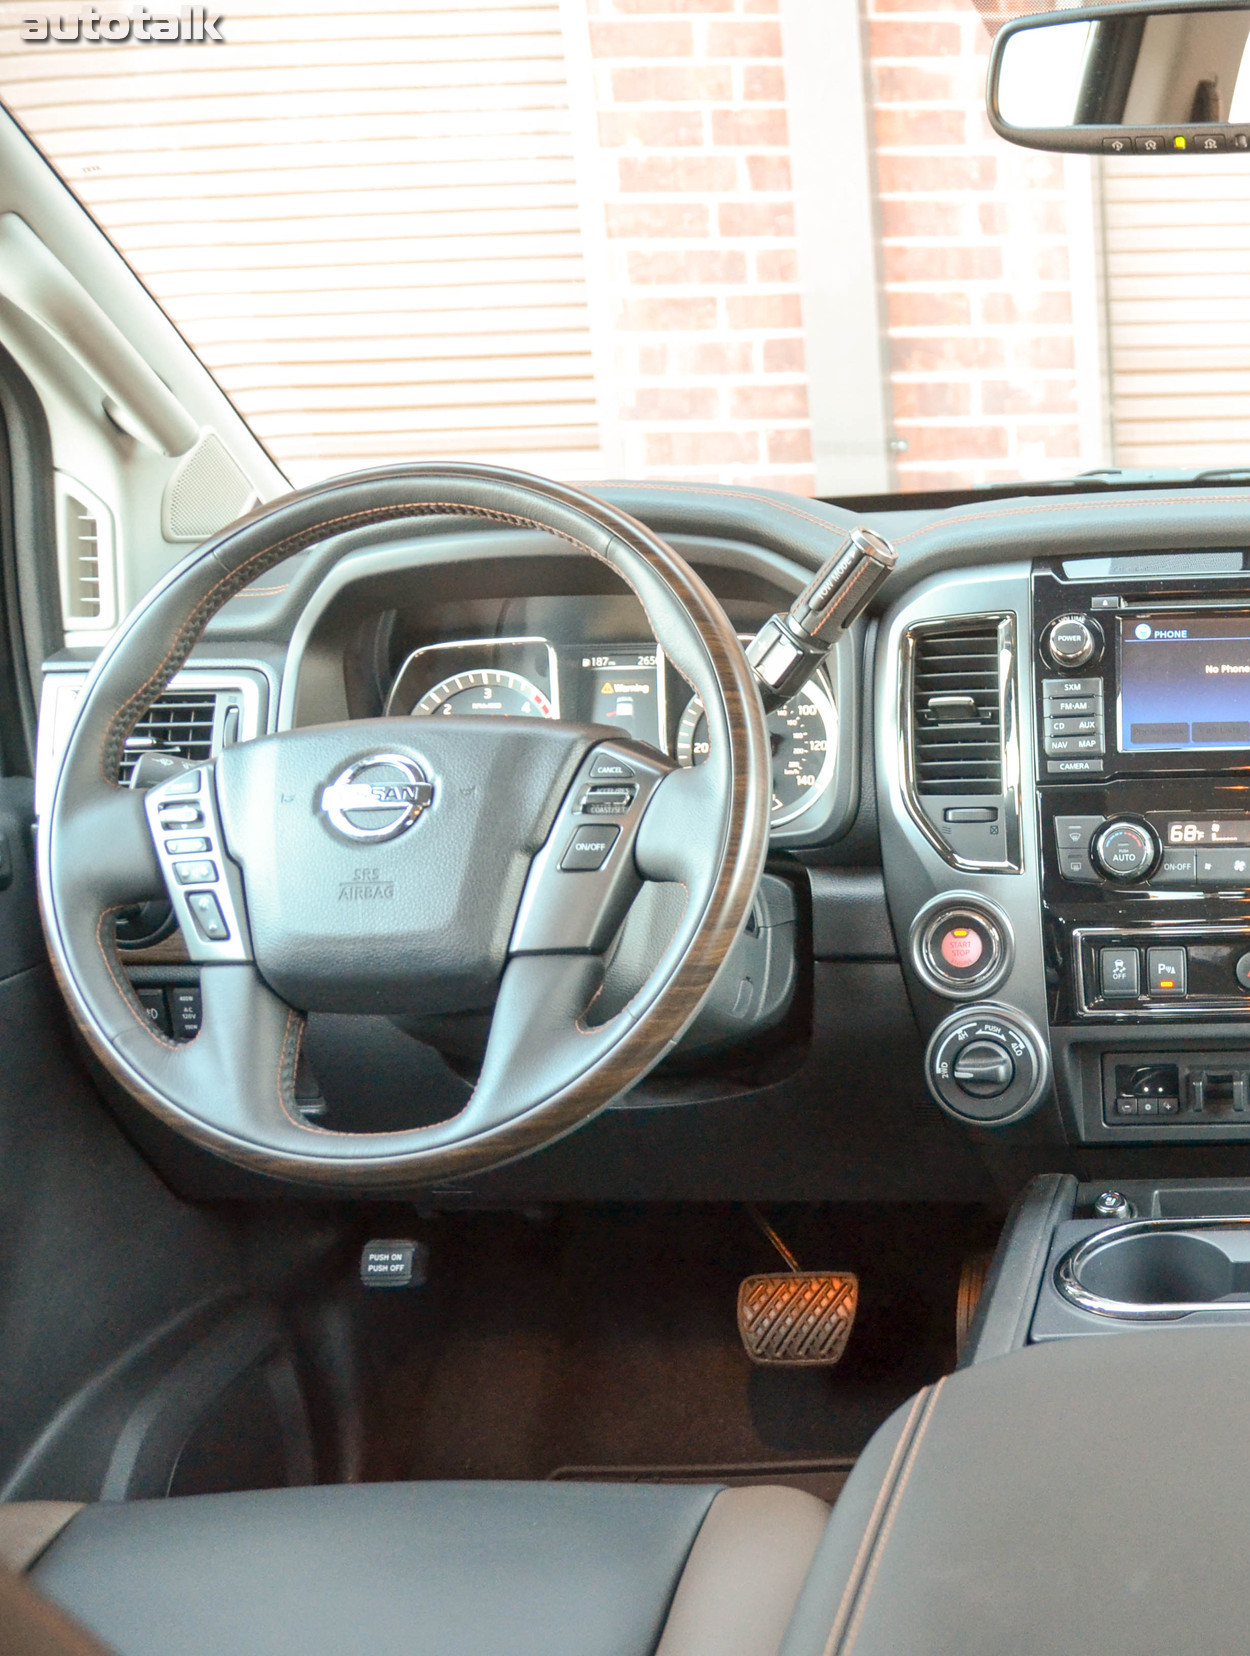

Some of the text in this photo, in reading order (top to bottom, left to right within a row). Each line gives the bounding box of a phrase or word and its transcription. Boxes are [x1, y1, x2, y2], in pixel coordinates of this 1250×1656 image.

[818, 558, 853, 600] TOW MODE
[1154, 630, 1188, 639] PHONE
[591, 657, 609, 666] 187
[1205, 665, 1219, 674] No
[1221, 664, 1250, 673] Phone
[483, 688, 492, 699] 3
[443, 703, 452, 715] 2
[521, 701, 531, 713] 4
[797, 705, 818, 715] 100
[693, 743, 709, 754] 20
[809, 740, 828, 751] 120
[1078, 740, 1096, 748] MAP
[796, 775, 816, 786] 140
[575, 842, 605, 851] ON/OFF
[1112, 854, 1136, 862] AUTO
[353, 868, 380, 881] SRS
[338, 885, 394, 901] AIRBAG
[951, 949, 971, 957] STOP
[984, 1024, 1002, 1034] PUSH
[957, 1031, 969, 1041] 4H
[1010, 1042, 1023, 1057] 4LO
[940, 1062, 949, 1079] 2WD
[369, 1253, 403, 1261] PUSH ON
[368, 1264, 405, 1272] PUSH OFF
